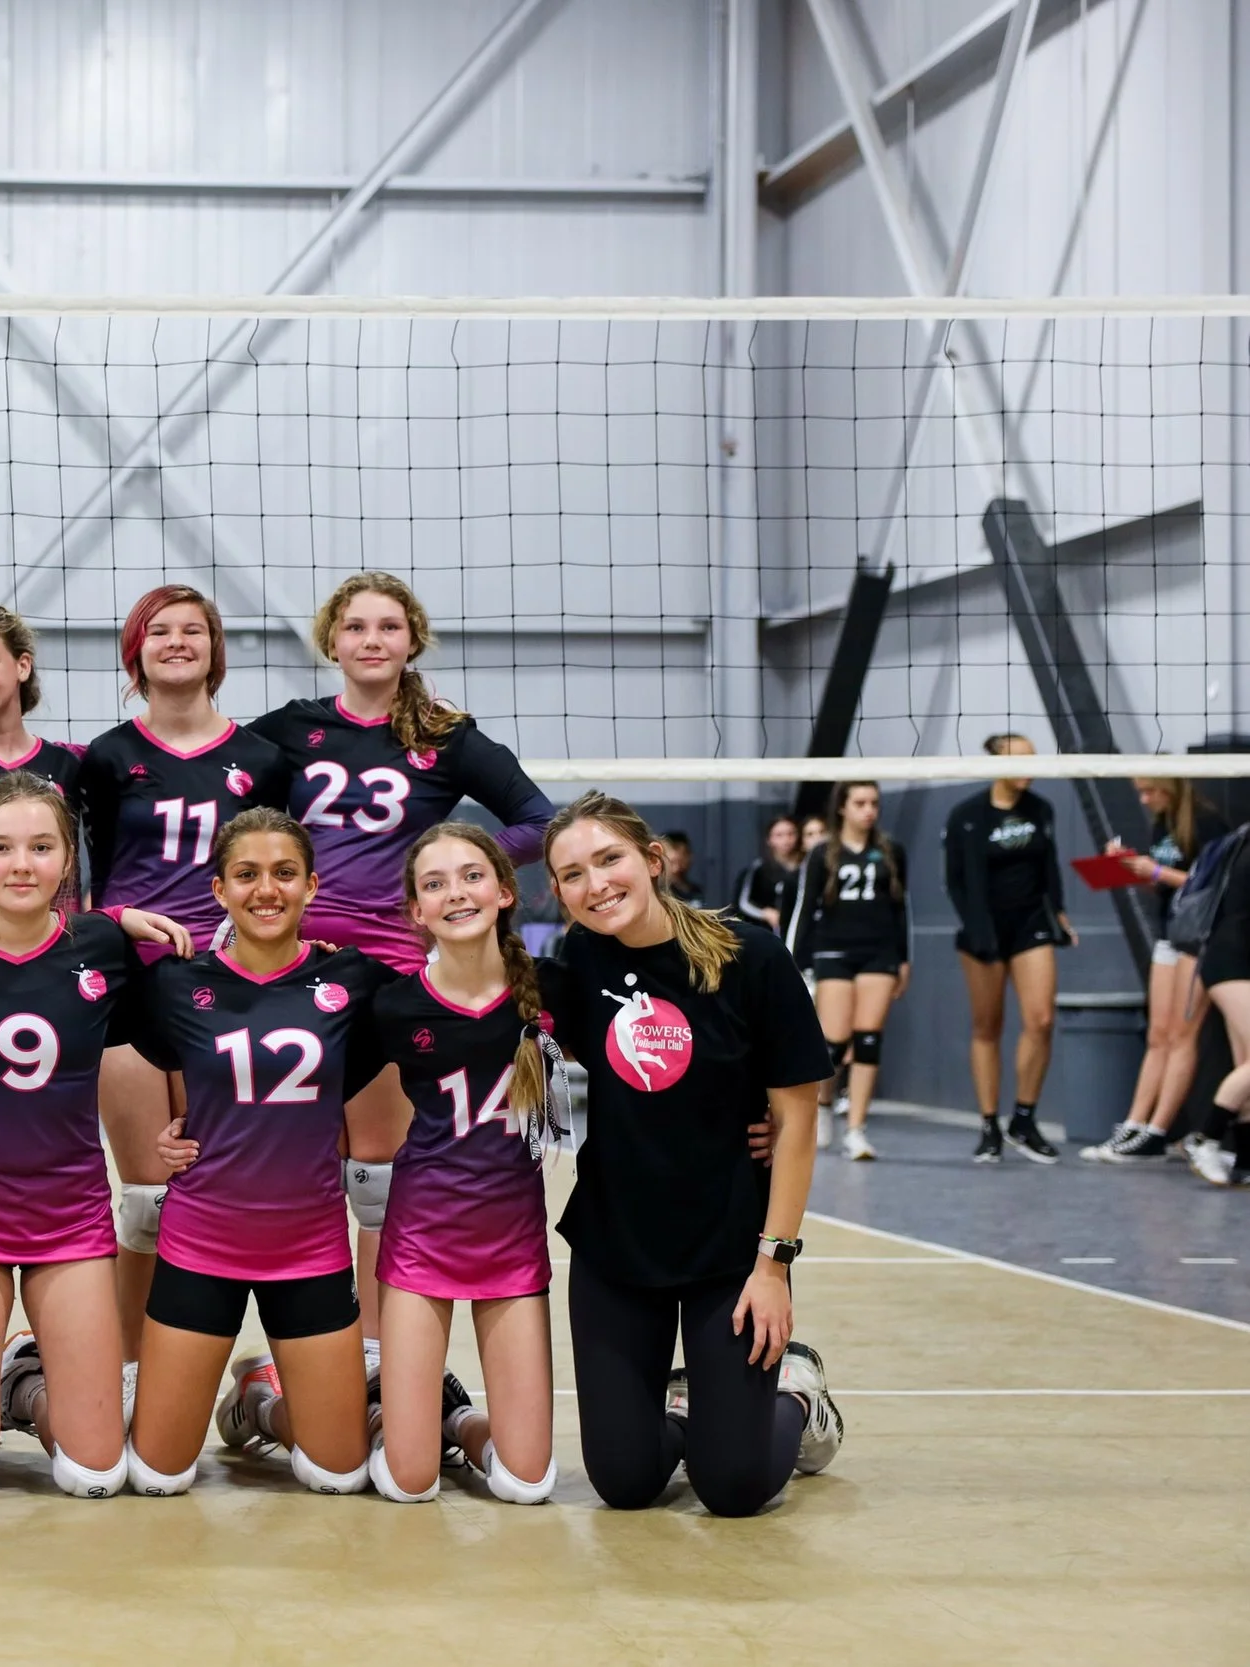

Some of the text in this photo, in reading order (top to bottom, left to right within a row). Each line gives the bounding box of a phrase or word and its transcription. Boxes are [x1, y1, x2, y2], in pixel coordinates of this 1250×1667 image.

[153, 797, 218, 866] 11
[300, 760, 411, 835] 23
[838, 863, 876, 900] 21
[214, 1027, 324, 1104] 12
[631, 1024, 693, 1041] POWERS
[668, 1040, 684, 1051] Club
[438, 1063, 520, 1138] 14
